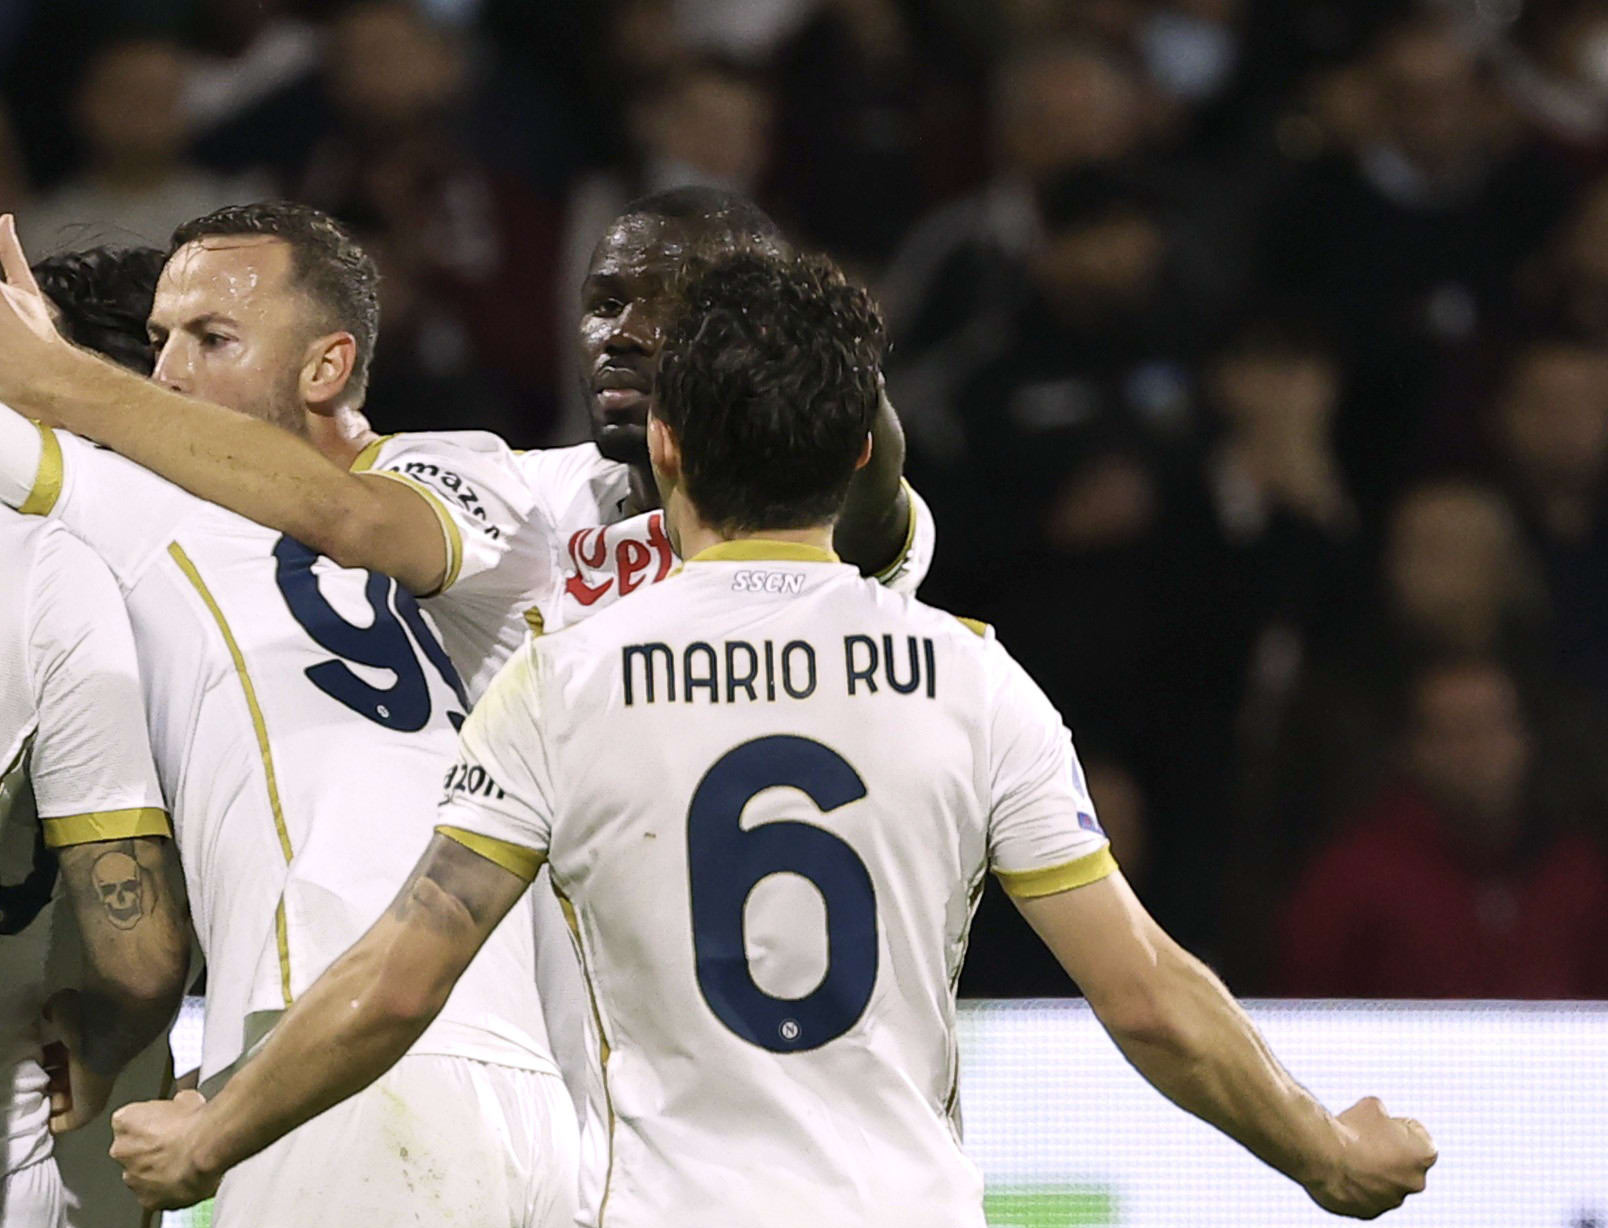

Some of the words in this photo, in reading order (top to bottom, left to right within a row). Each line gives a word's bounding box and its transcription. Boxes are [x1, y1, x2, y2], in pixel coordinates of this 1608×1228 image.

[731, 570, 807, 596] SSCN
[621, 635, 818, 707] MARIO
[844, 635, 937, 700] RUI
[684, 733, 880, 1055] 6
